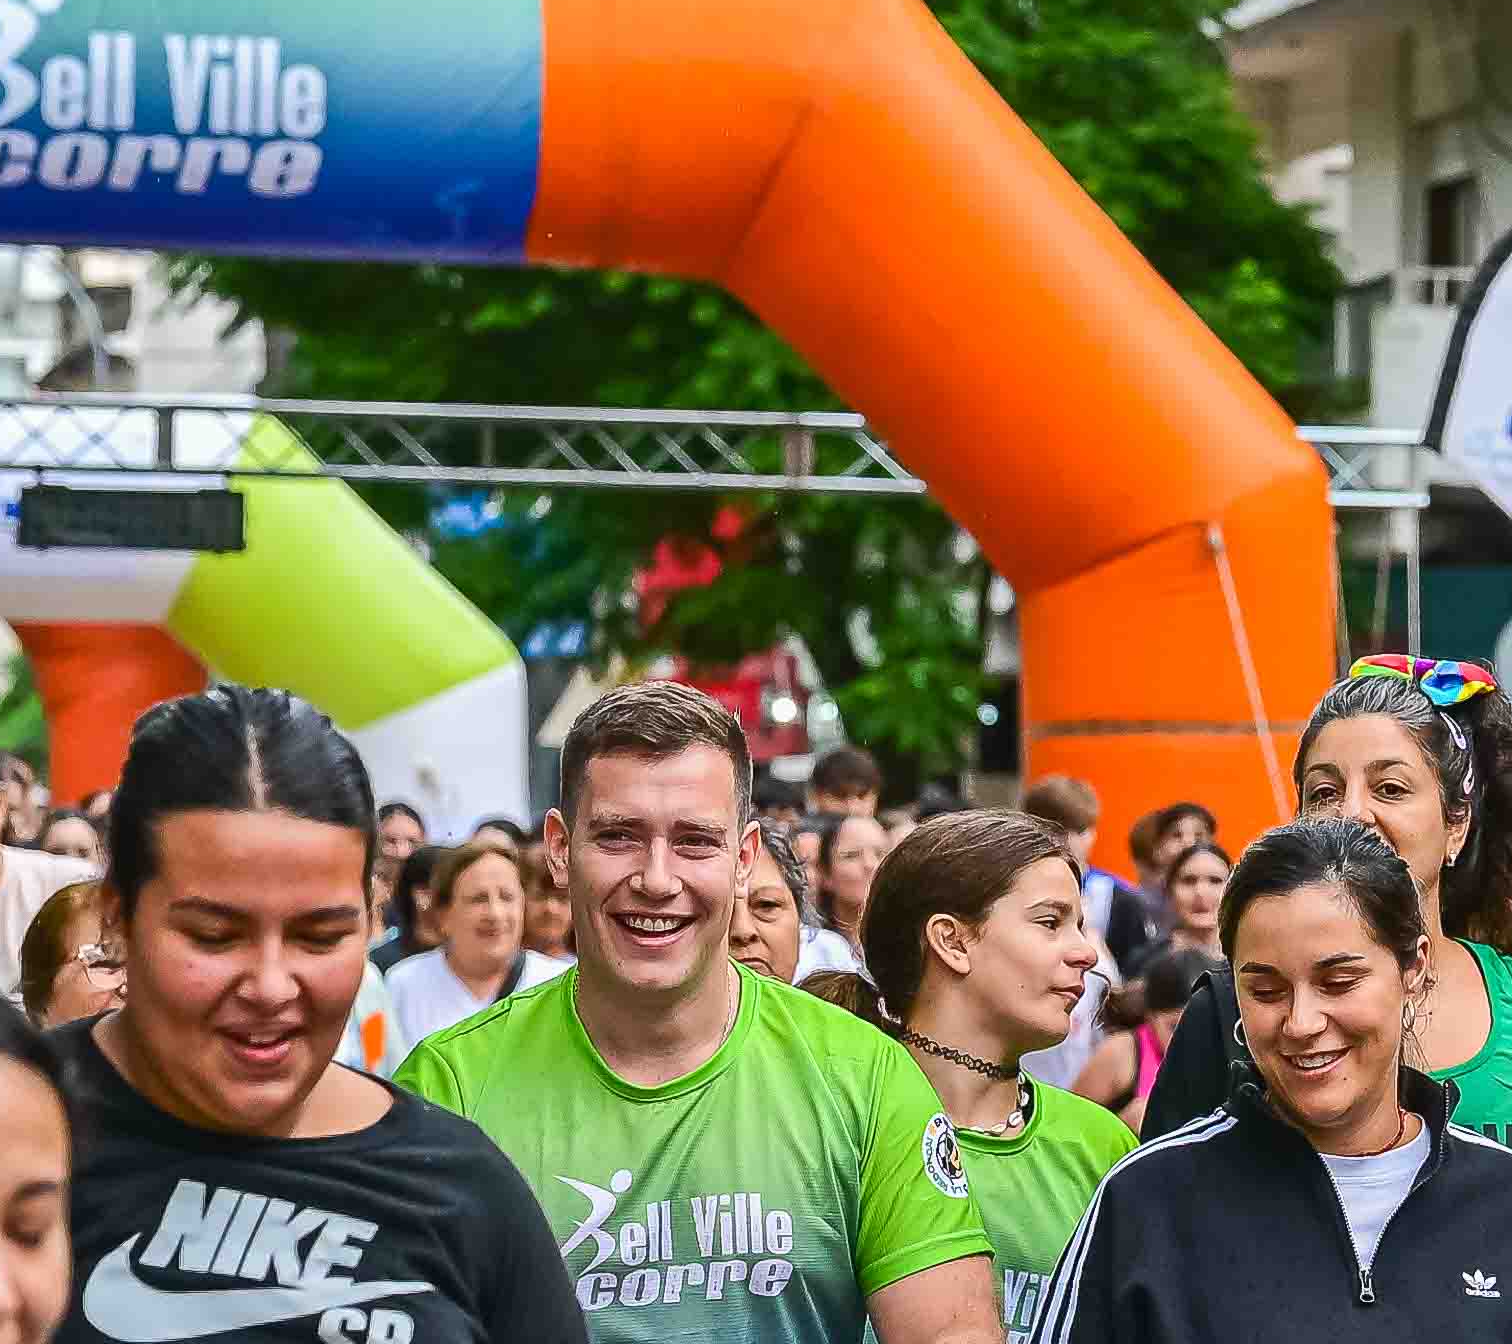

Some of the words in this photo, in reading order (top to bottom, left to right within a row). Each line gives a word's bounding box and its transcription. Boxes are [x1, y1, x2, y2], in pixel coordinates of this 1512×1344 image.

[164, 33, 328, 138] Ville
[138, 1178, 380, 1290] NIKE
[690, 1192, 794, 1258] Ville
[575, 1258, 794, 1312] corre
